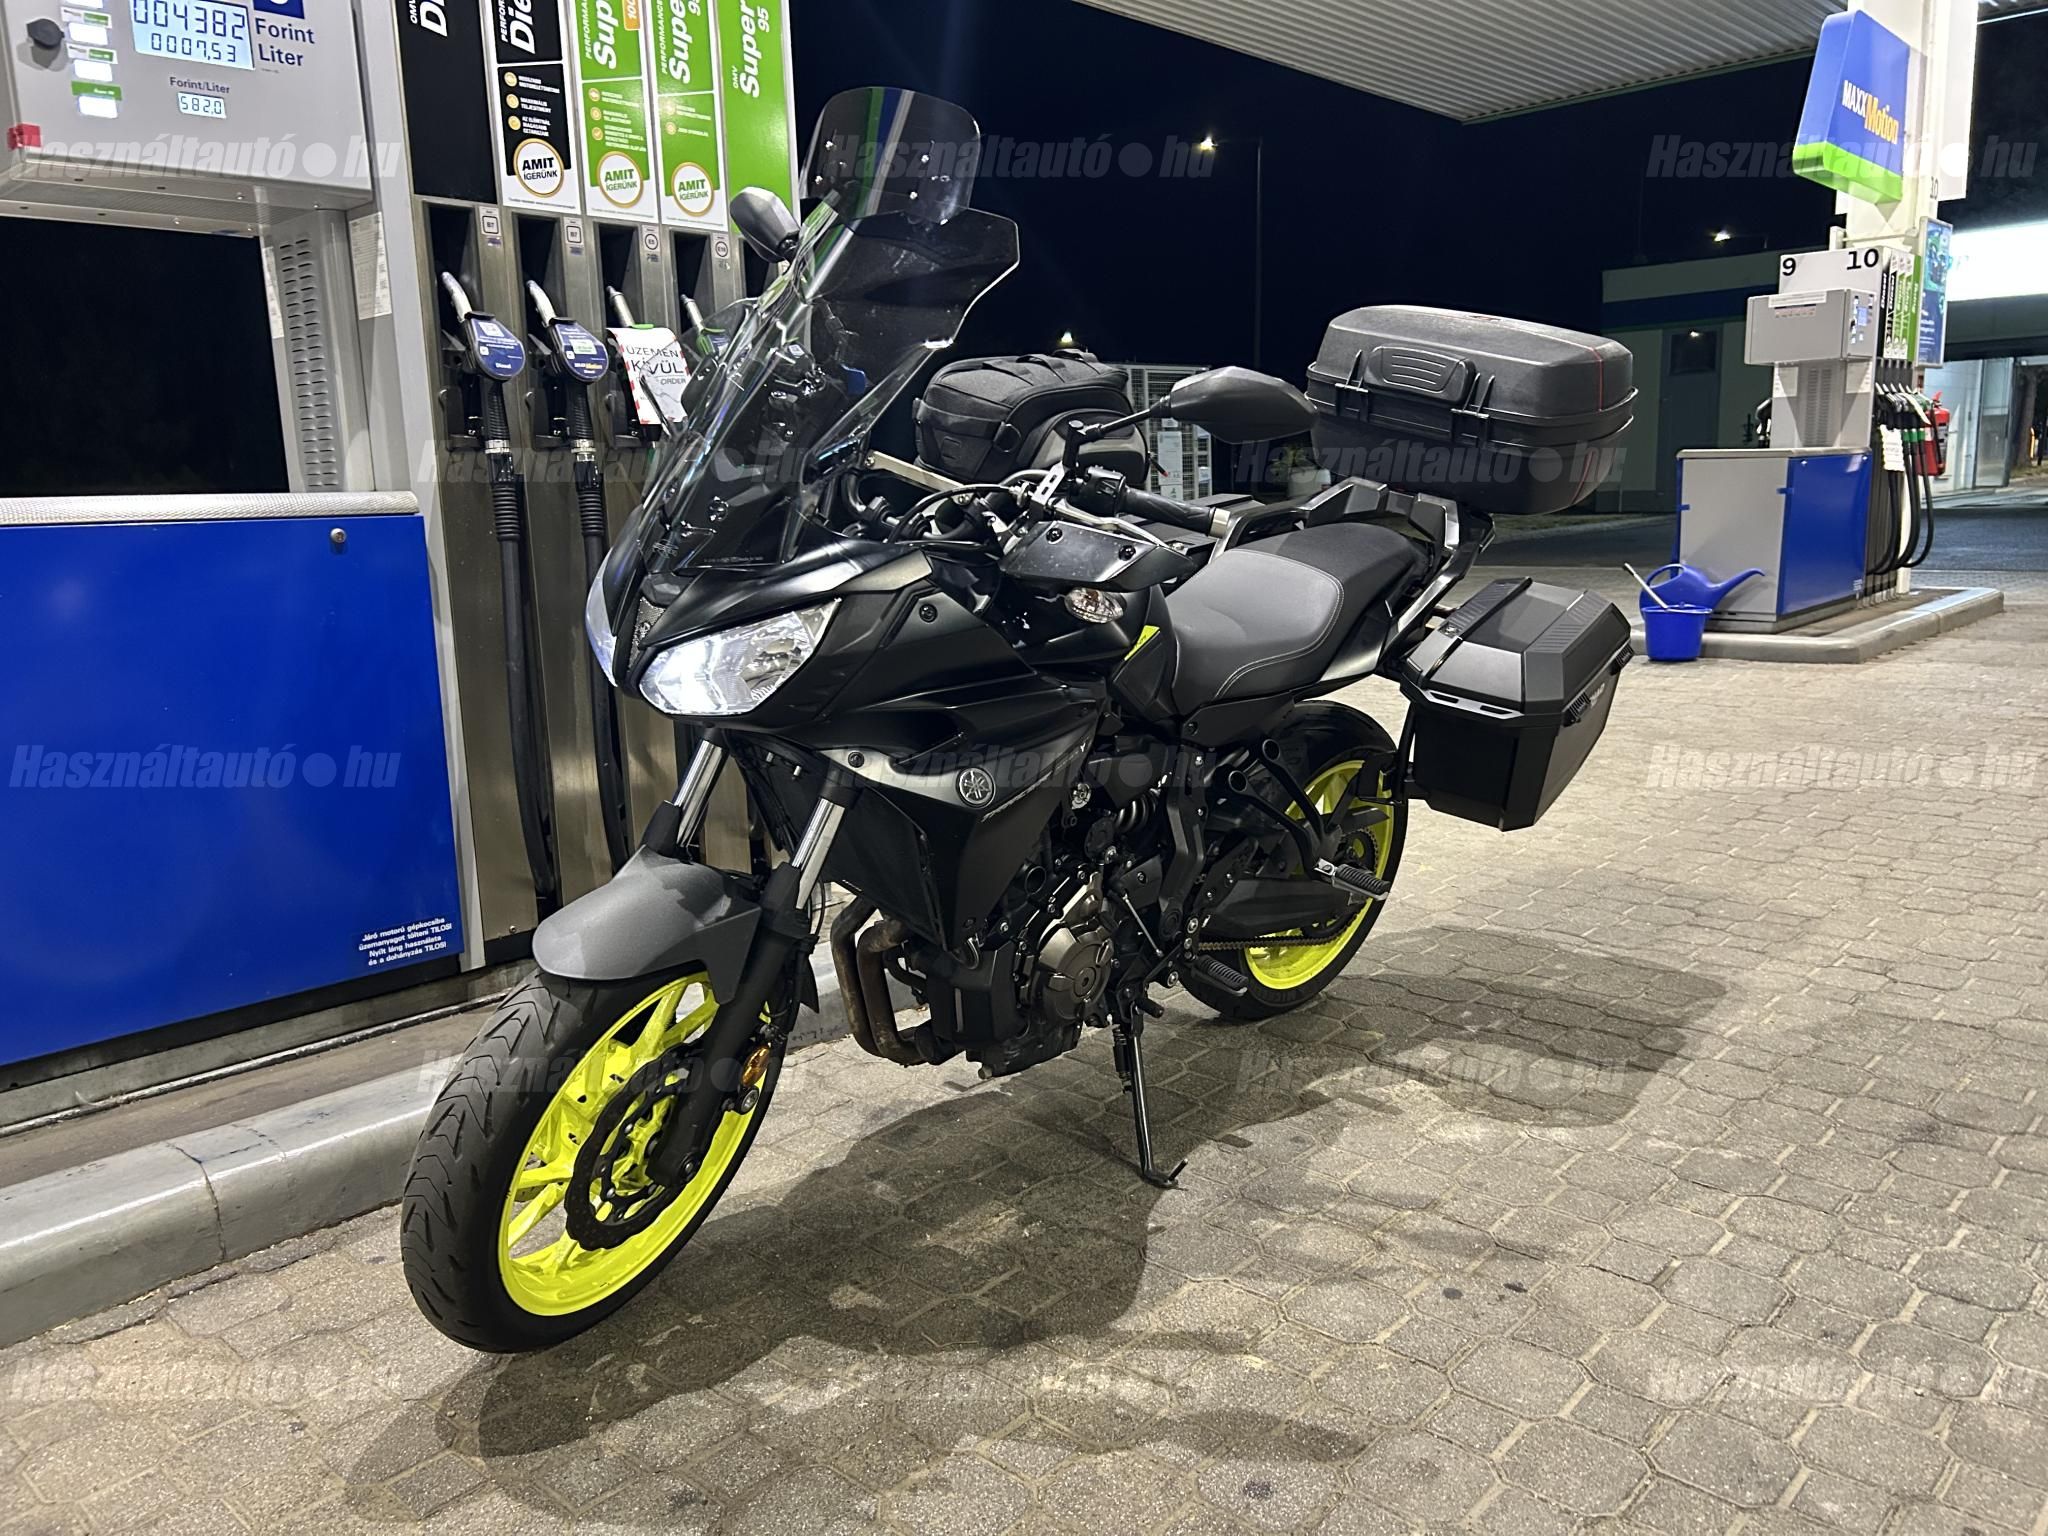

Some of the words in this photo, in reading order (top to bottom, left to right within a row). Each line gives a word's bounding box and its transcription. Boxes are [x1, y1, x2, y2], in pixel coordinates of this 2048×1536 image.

[687, 0, 701, 16] 9
[757, 5, 770, 33] 95
[134, 0, 245, 40] 004382
[255, 18, 315, 44] Forint
[258, 43, 303, 66] Liter
[740, 0, 762, 98] Super
[169, 76, 230, 94] Forint/Liter
[731, 65, 739, 89] OMV
[522, 157, 554, 171] AMIT
[604, 168, 634, 182] AMIT
[678, 179, 705, 192] AMIT
[1782, 257, 1796, 276] 9
[1846, 248, 1879, 270] 10
